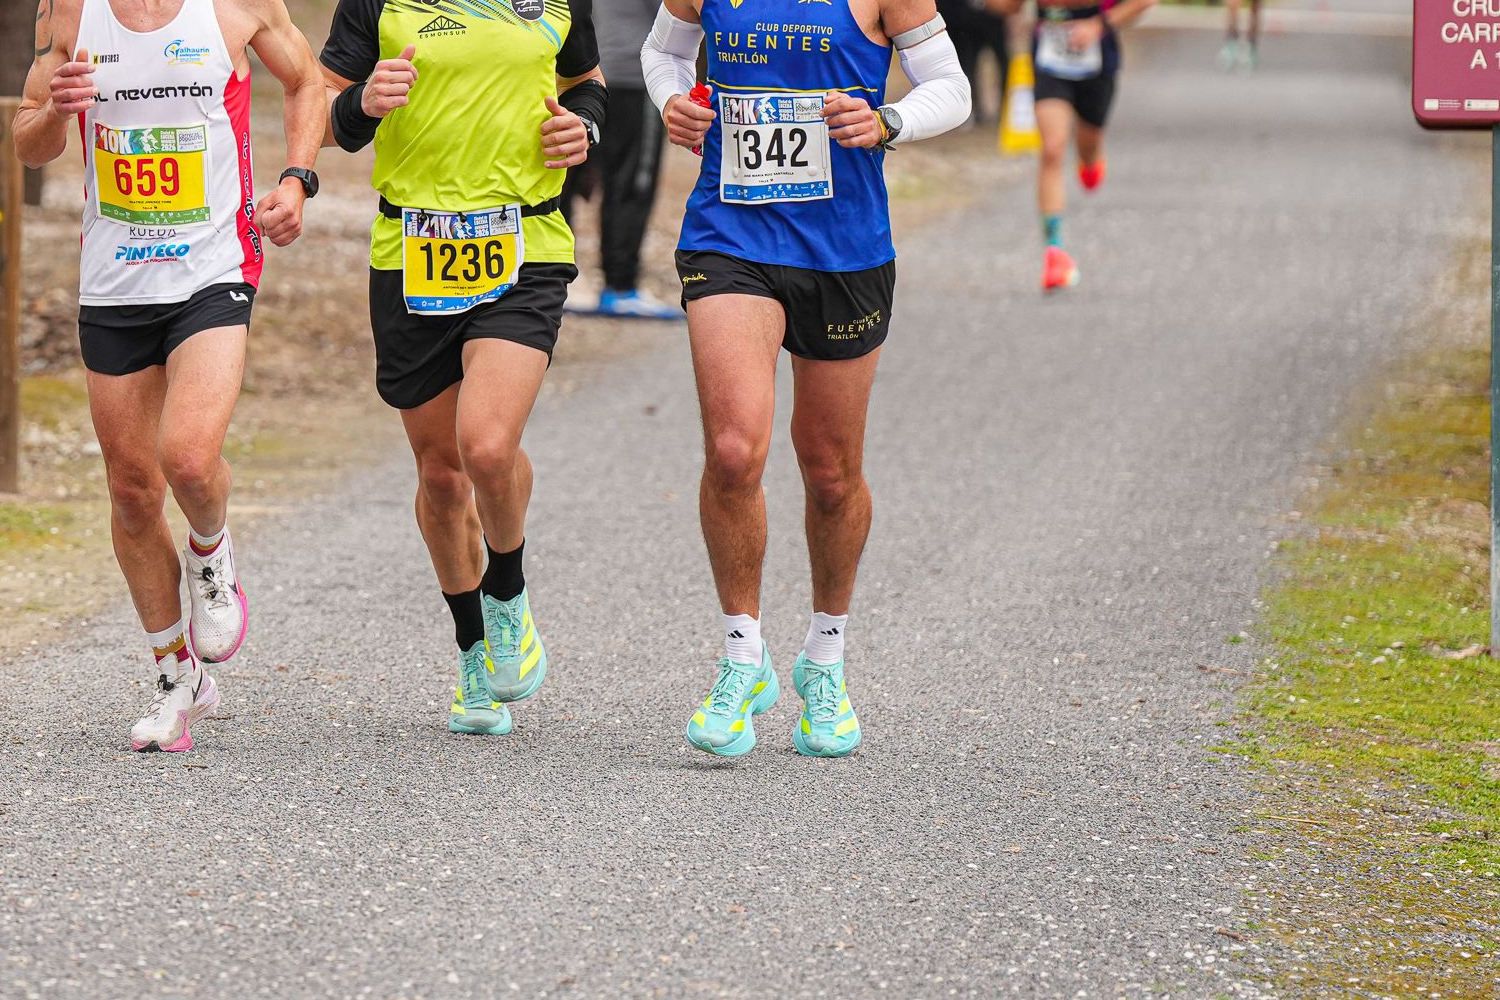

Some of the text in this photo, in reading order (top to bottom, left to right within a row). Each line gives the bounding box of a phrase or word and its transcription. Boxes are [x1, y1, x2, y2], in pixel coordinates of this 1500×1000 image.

[419, 30, 466, 39] ESMONSUR
[755, 22, 833, 35] CLUB DEPORTIVO
[715, 31, 831, 52] FUENTES
[717, 51, 768, 64] TRIATLÓN
[1470, 48, 1488, 70] A
[100, 126, 135, 155] 10K
[732, 127, 809, 170] 1342
[113, 157, 180, 197] 659
[115, 243, 190, 261] PINYECO
[419, 239, 505, 282] 1236
[827, 314, 881, 333] FUENTES
[827, 332, 859, 340] TRIATLÓN
